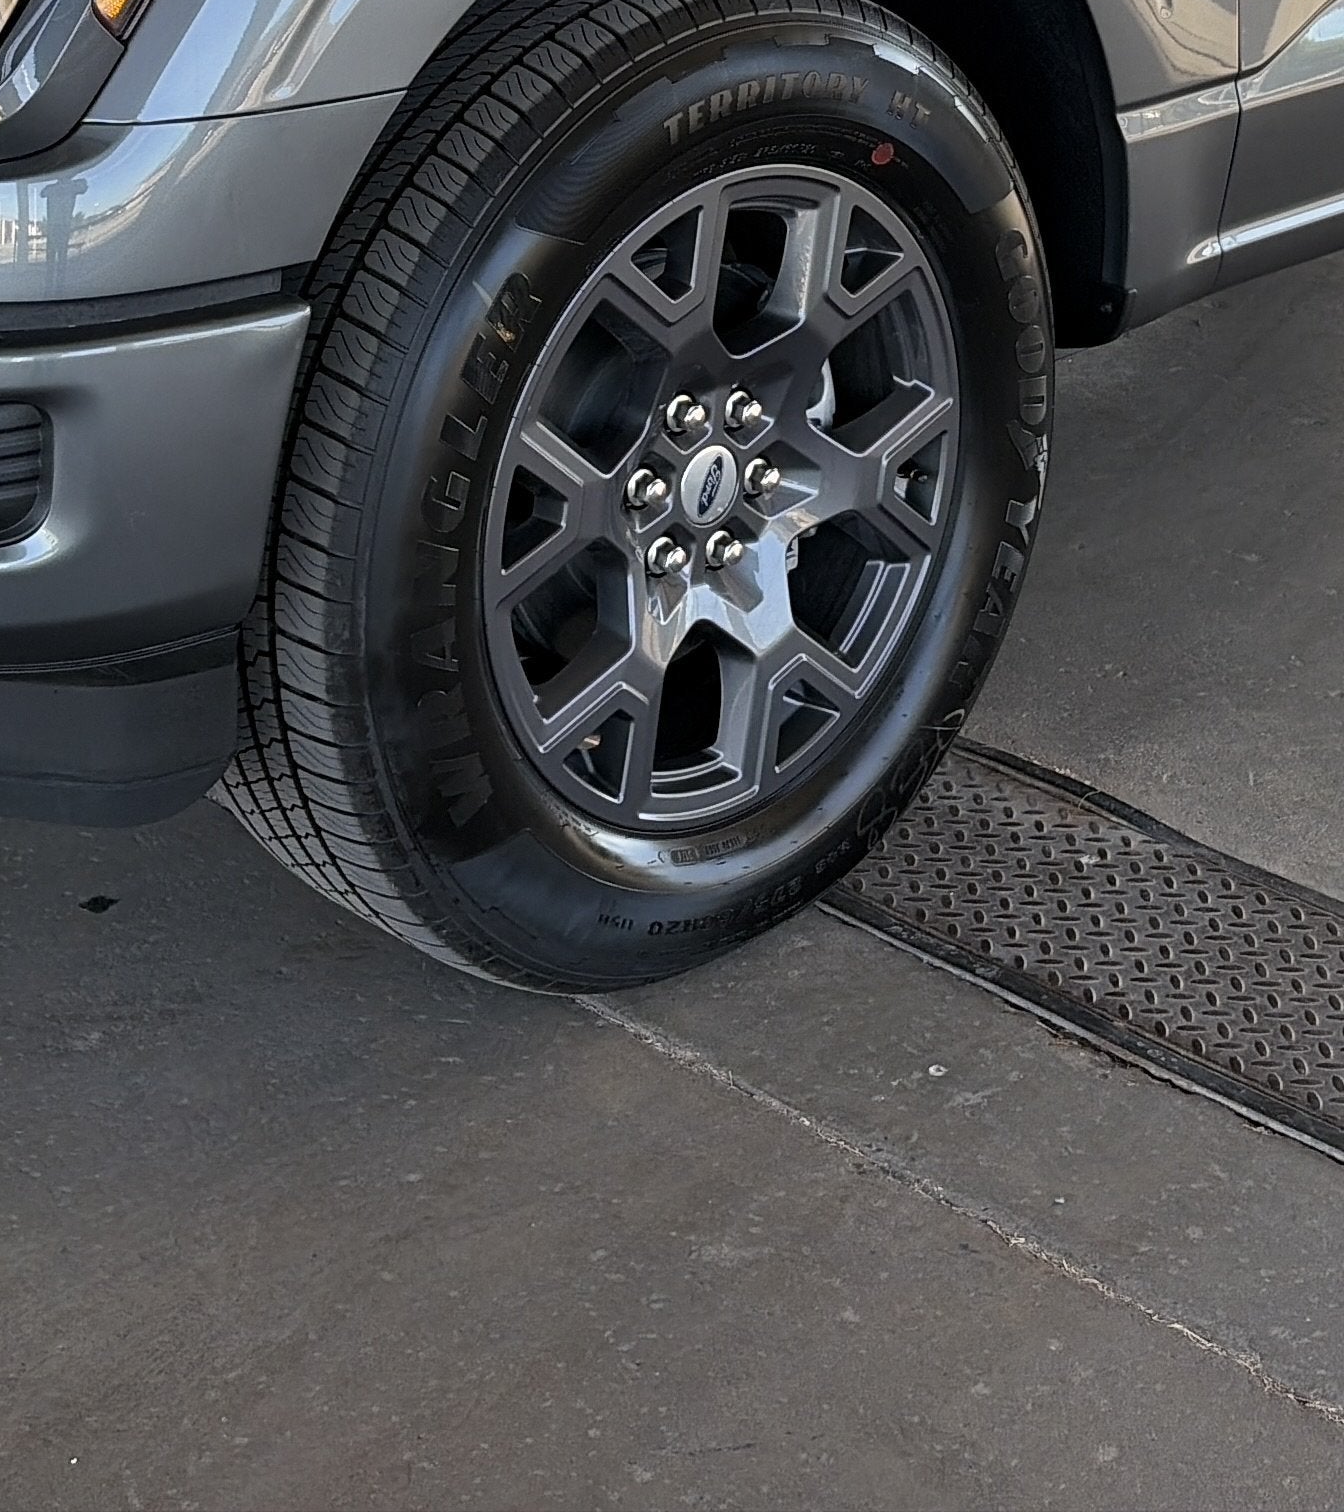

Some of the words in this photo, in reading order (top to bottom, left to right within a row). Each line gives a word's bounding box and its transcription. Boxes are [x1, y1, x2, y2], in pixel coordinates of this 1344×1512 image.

[663, 70, 870, 145] TERRITORY
[886, 89, 932, 129] HT
[701, 464, 721, 507] Ford
